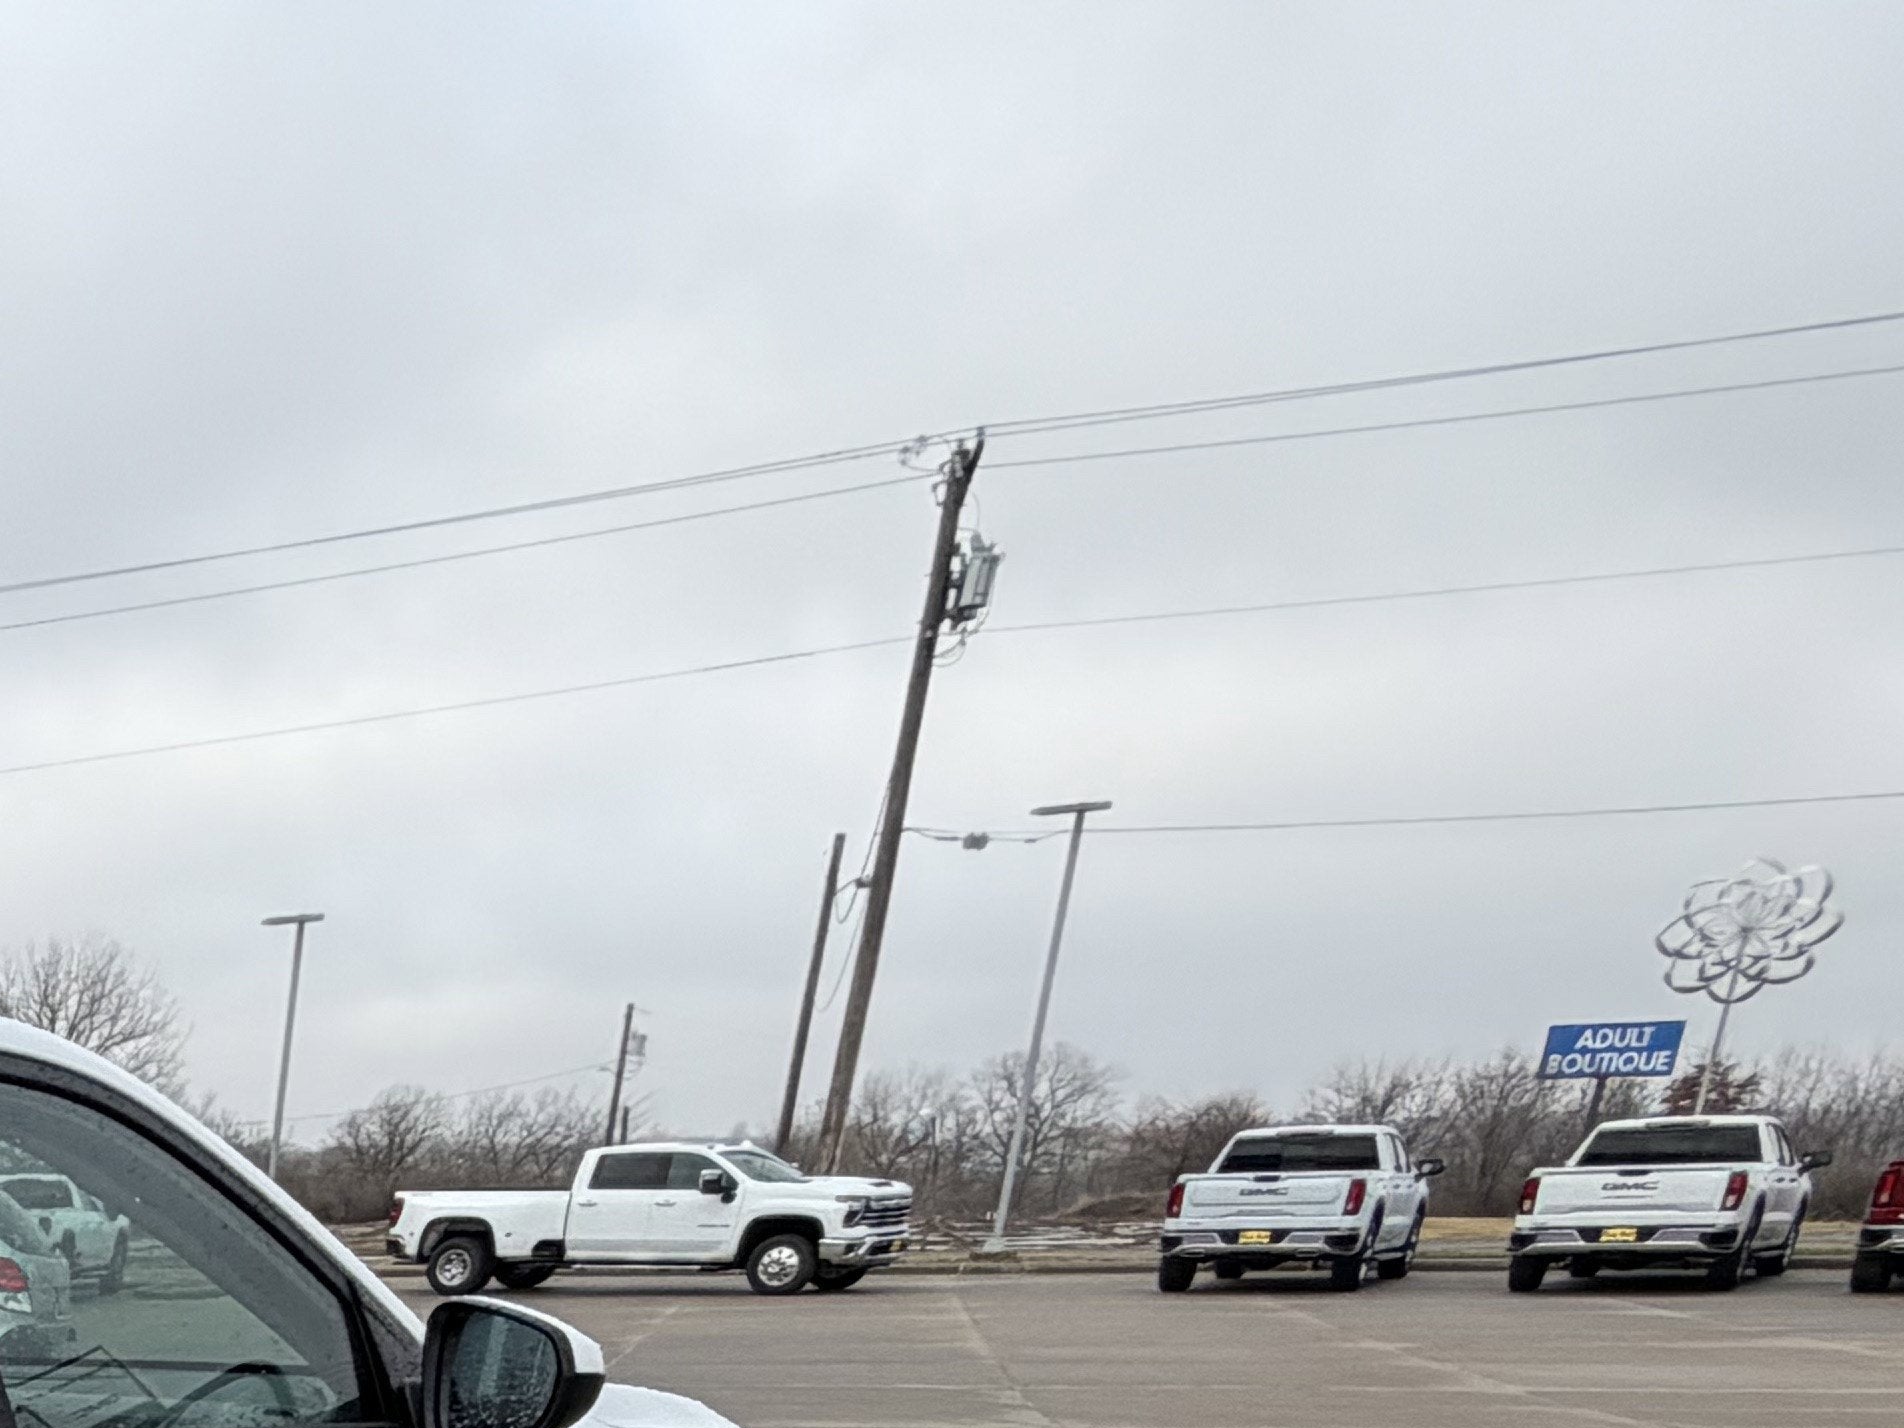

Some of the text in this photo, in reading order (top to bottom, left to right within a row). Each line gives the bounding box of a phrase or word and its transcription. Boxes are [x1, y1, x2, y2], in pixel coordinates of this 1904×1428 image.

[1574, 1026, 1656, 1049] ADULT
[1545, 1051, 1672, 1074] BOUTIQUE
[1601, 1181, 1659, 1191] GMC
